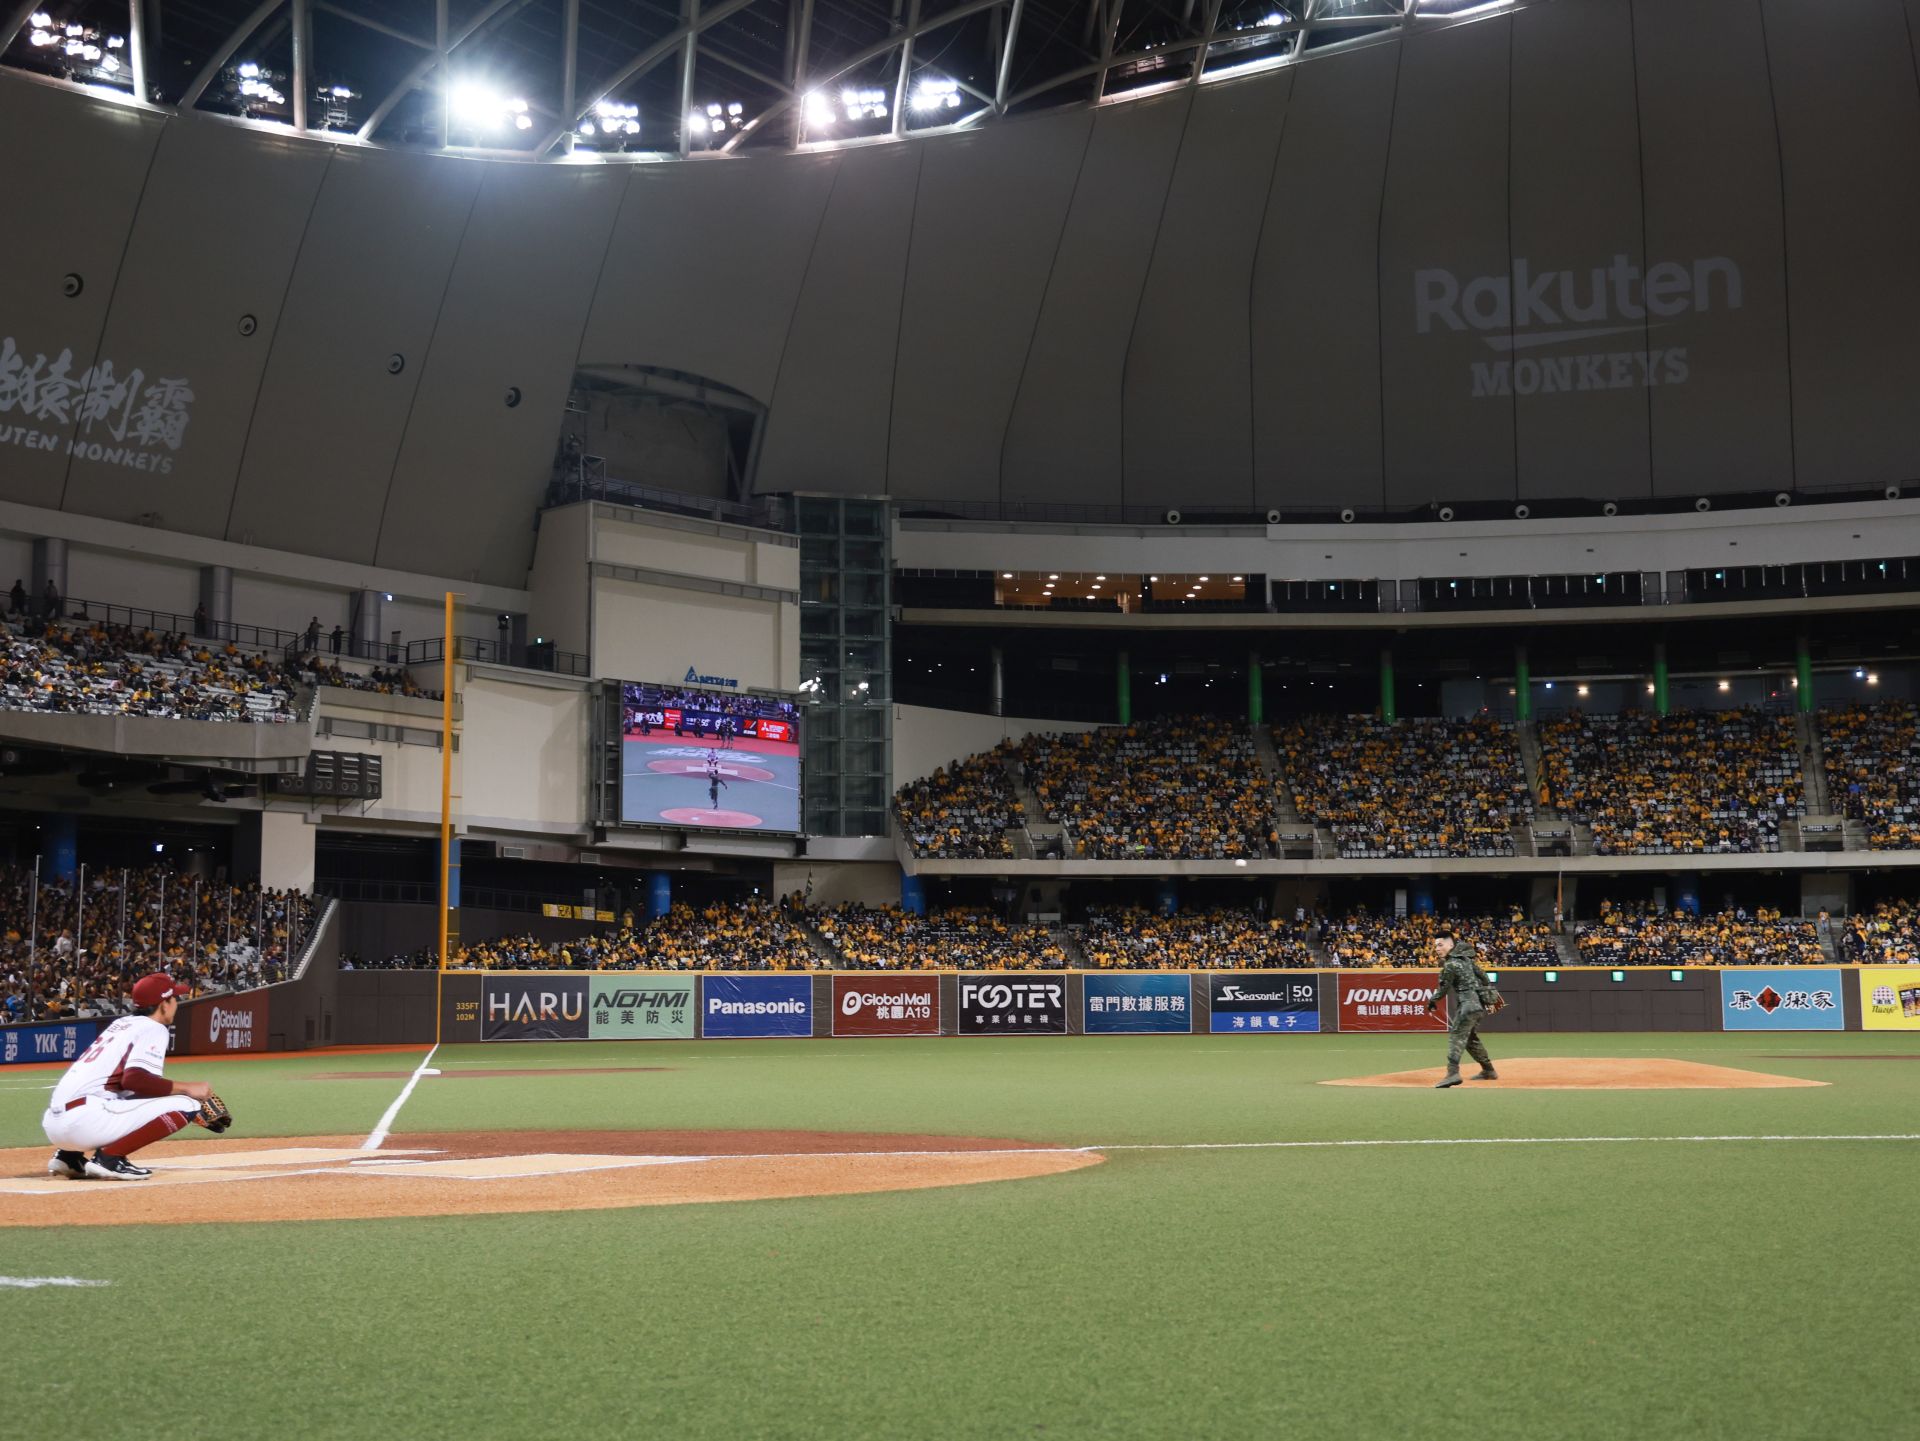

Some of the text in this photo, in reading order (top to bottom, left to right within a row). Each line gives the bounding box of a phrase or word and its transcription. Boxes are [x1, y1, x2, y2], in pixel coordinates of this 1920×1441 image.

[1414, 254, 1742, 333] Rakuten
[1470, 348, 1690, 397] MONKEYS
[66, 440, 173, 473] MONKEYS
[593, 989, 690, 1008] NOHMI
[962, 984, 1062, 1008] FOOTER
[1235, 991, 1283, 1001] Seasonic
[1293, 985, 1313, 998] 50
[1344, 988, 1437, 1005] JOHNSON
[456, 1002, 479, 1010] 335FT
[489, 991, 582, 1024] HARU
[709, 998, 806, 1014] Panasonic
[1089, 996, 1185, 1012] 雷門數據服務
[1356, 1005, 1424, 1016] 喬山健康科技
[596, 1010, 683, 1025] 能美防災
[1232, 1015, 1297, 1028] 海韻電子
[6, 1032, 18, 1043] YKK
[64, 1027, 77, 1039] YKK
[35, 1034, 57, 1053] YKK
[63, 1039, 76, 1058] ap
[5, 1044, 18, 1061] ap
